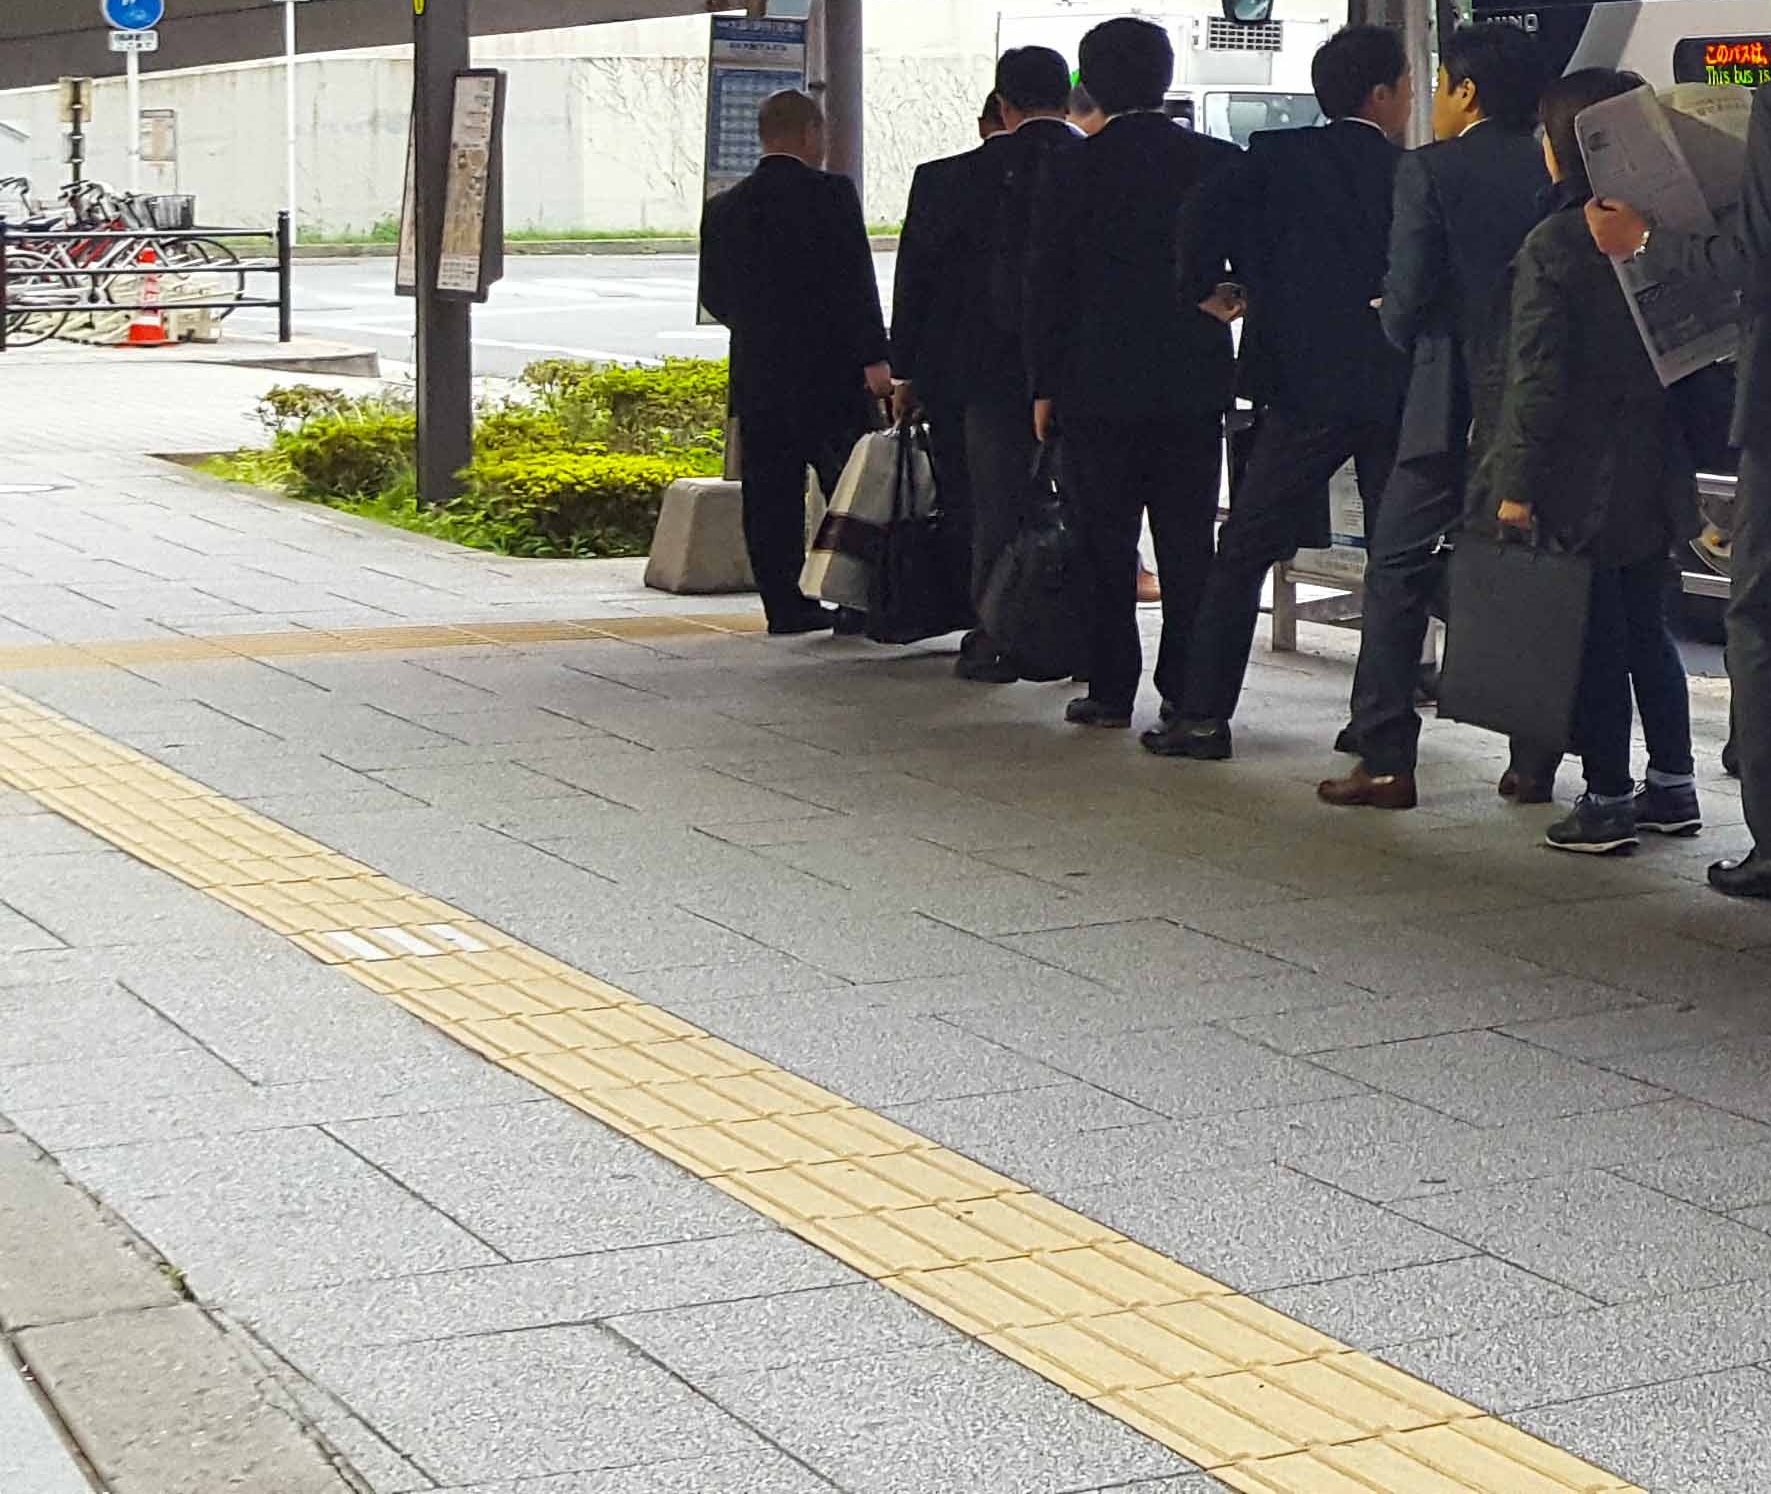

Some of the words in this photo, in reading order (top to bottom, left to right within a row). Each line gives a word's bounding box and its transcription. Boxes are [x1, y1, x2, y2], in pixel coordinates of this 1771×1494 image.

[1705, 66, 1730, 85] This
[1734, 64, 1753, 84] bus
[1760, 68, 1771, 84] is
